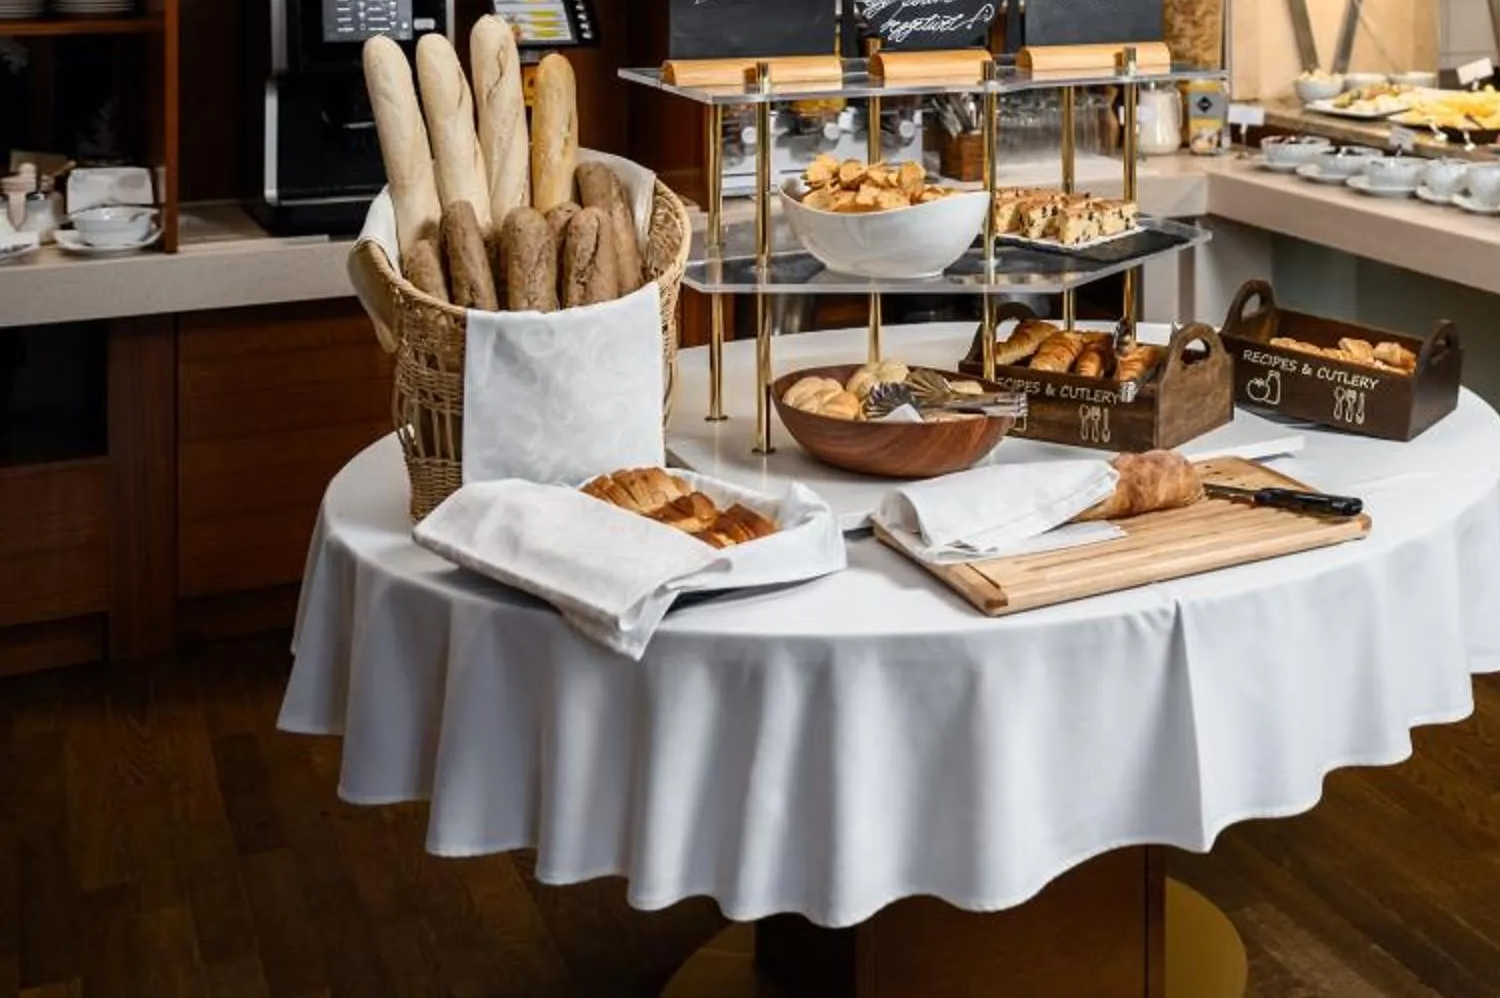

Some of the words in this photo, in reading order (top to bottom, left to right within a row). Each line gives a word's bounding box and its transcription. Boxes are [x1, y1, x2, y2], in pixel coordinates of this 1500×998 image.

[1243, 349, 1298, 373] RECIPES
[1301, 362, 1312, 376] &
[1317, 366, 1380, 390] CUTLERY
[997, 376, 1041, 395] ECIPES
[1045, 382, 1057, 397] &
[1059, 384, 1120, 405] CUTLERY
